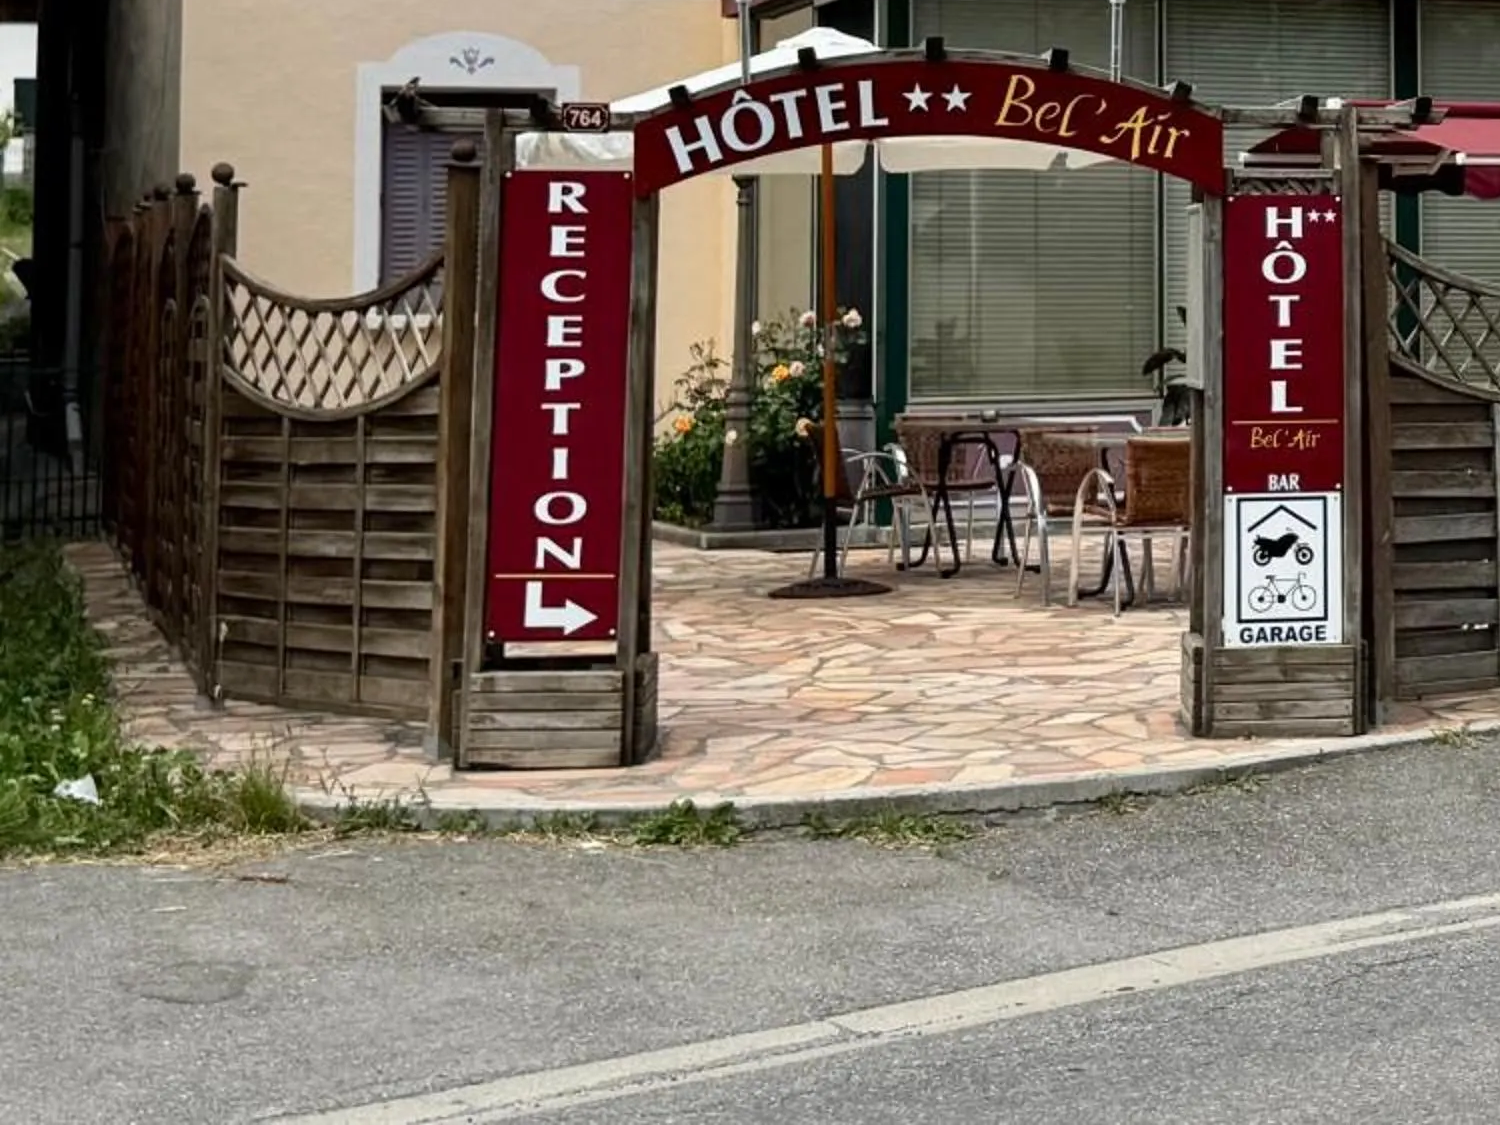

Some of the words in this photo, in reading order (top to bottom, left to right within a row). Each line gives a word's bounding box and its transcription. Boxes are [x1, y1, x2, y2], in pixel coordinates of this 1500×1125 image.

[569, 108, 602, 127] 764
[665, 79, 890, 174] HÔTEL
[1099, 105, 1191, 161] Air
[1261, 206, 1308, 413] HÔTEL
[533, 181, 590, 570] RECEPTION
[1267, 472, 1301, 492] BAR
[1239, 624, 1328, 645] GARAGE
